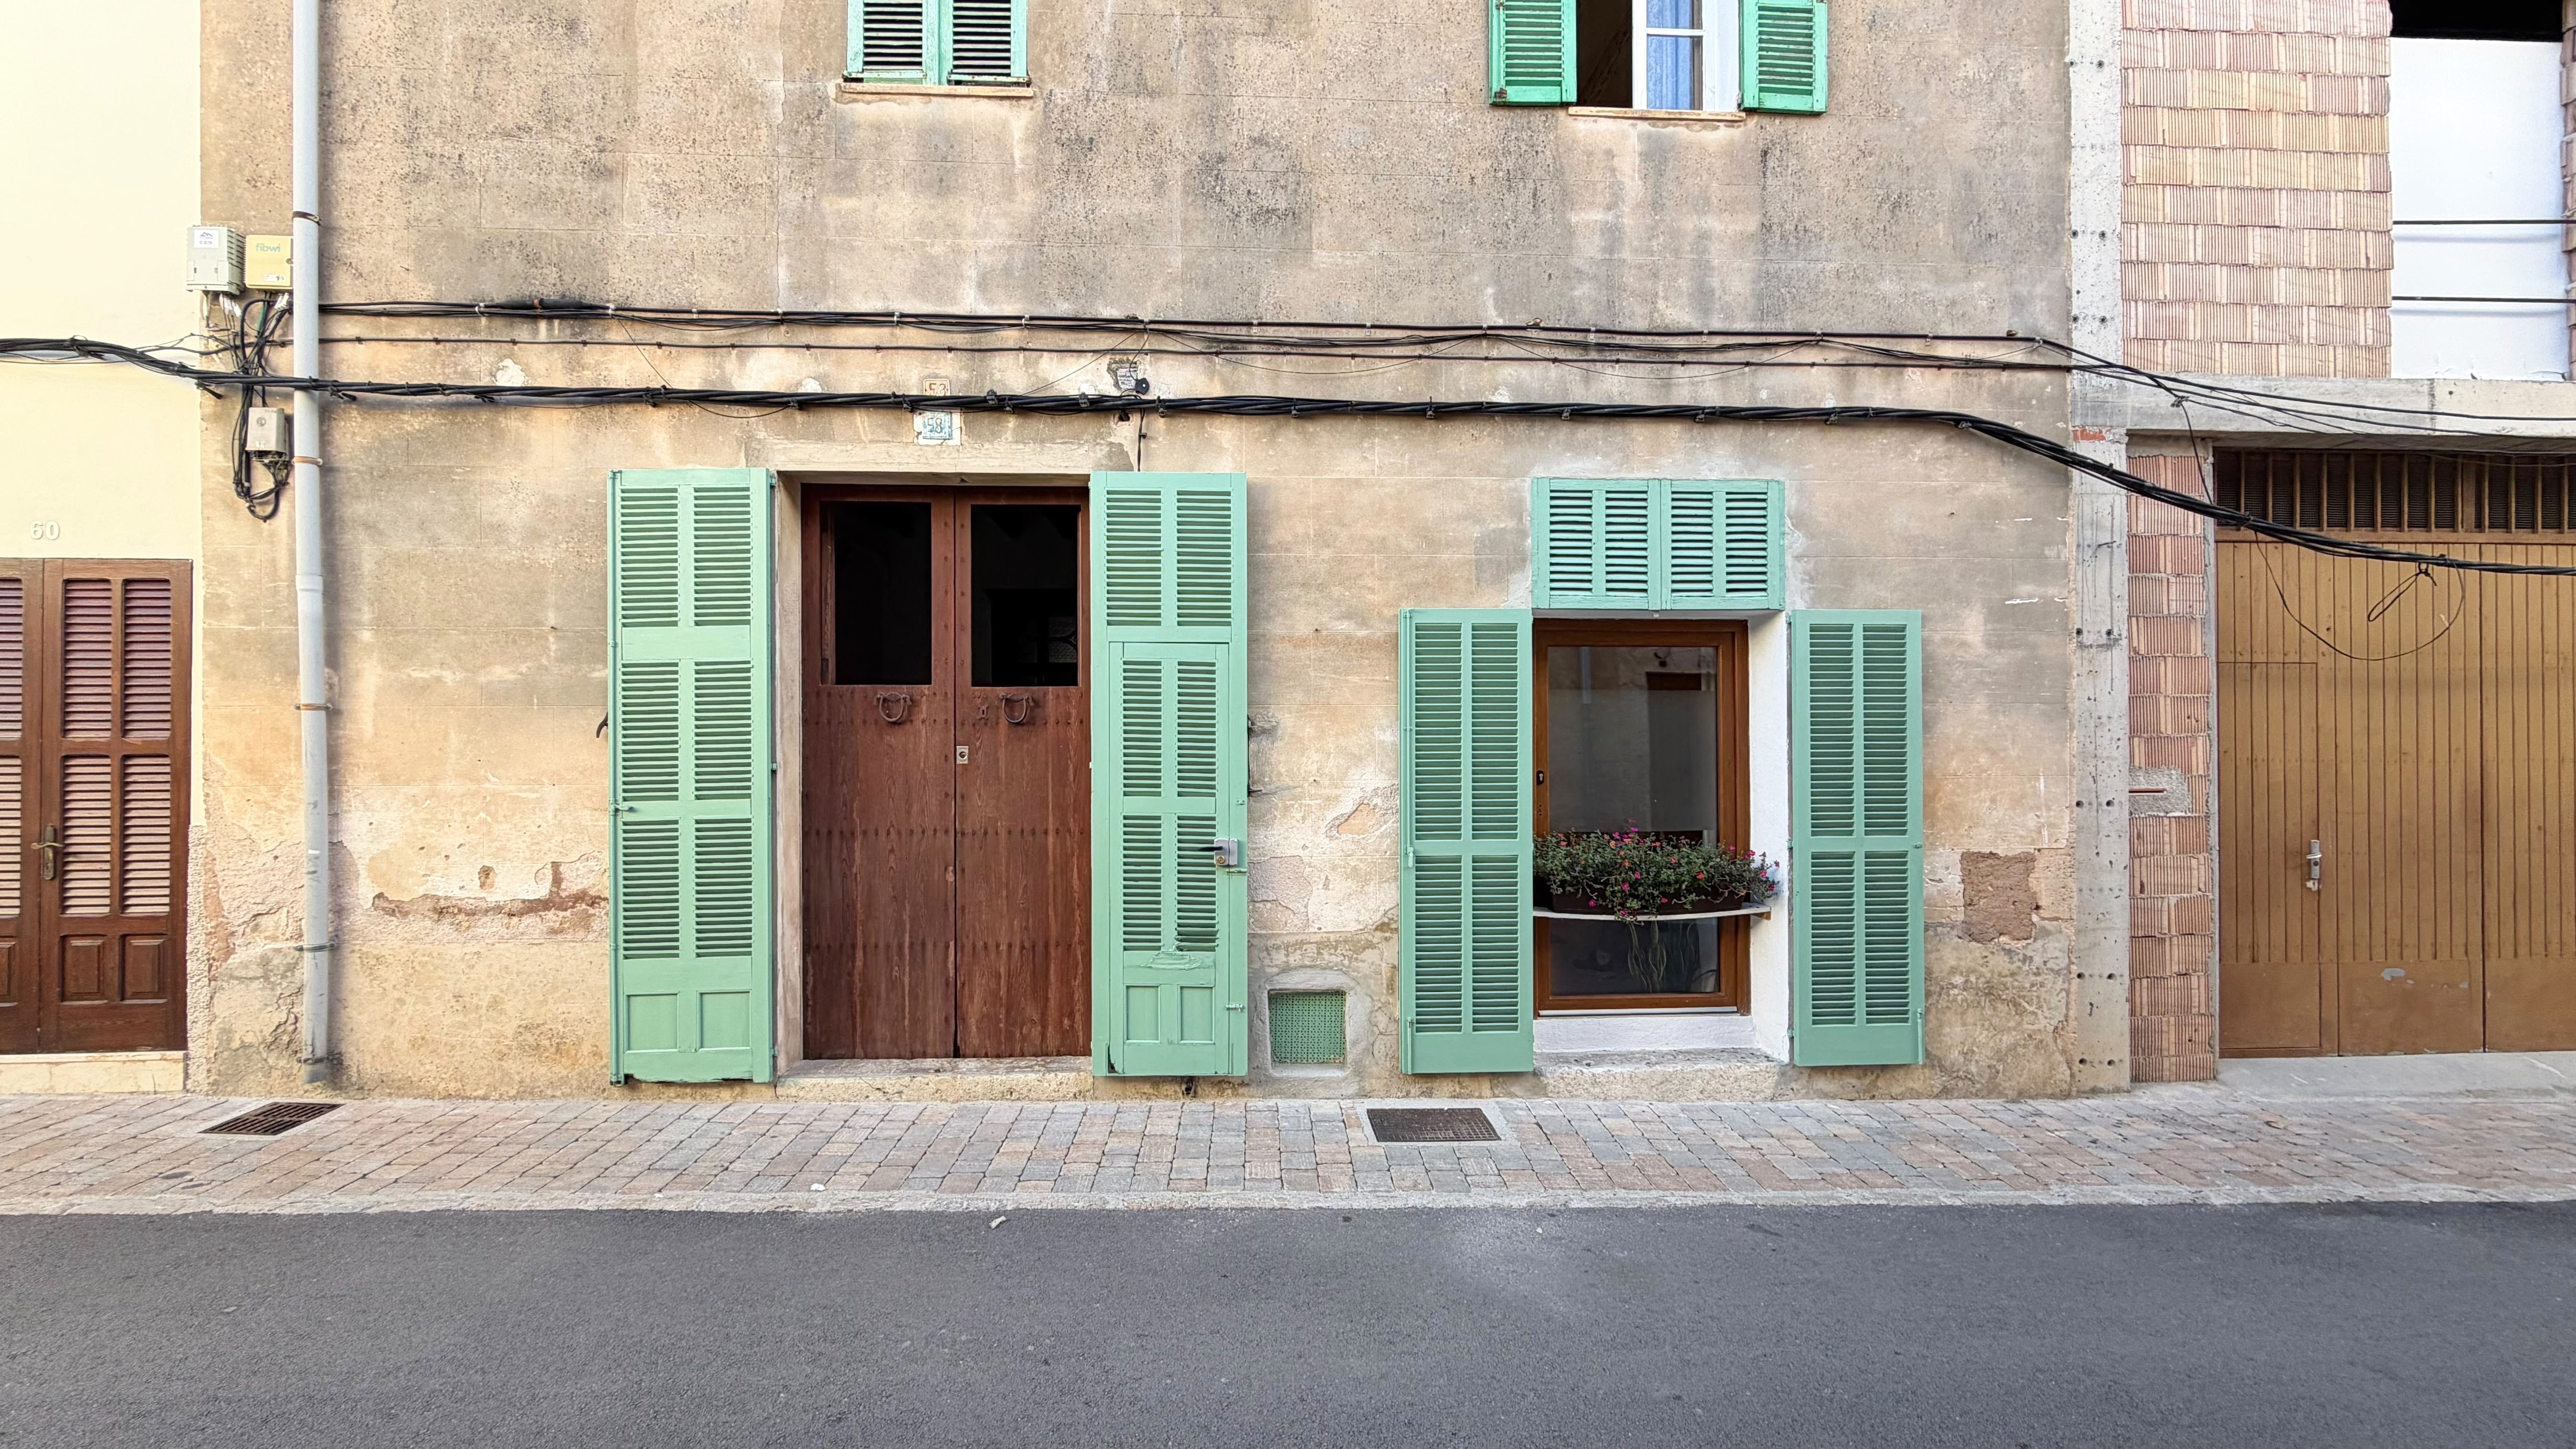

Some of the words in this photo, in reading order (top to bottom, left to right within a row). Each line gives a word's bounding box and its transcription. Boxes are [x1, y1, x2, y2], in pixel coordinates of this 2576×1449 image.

[256, 243, 281, 252] fibwi
[929, 383, 946, 396] 58
[927, 418, 943, 433] 58
[30, 520, 60, 540] 60
